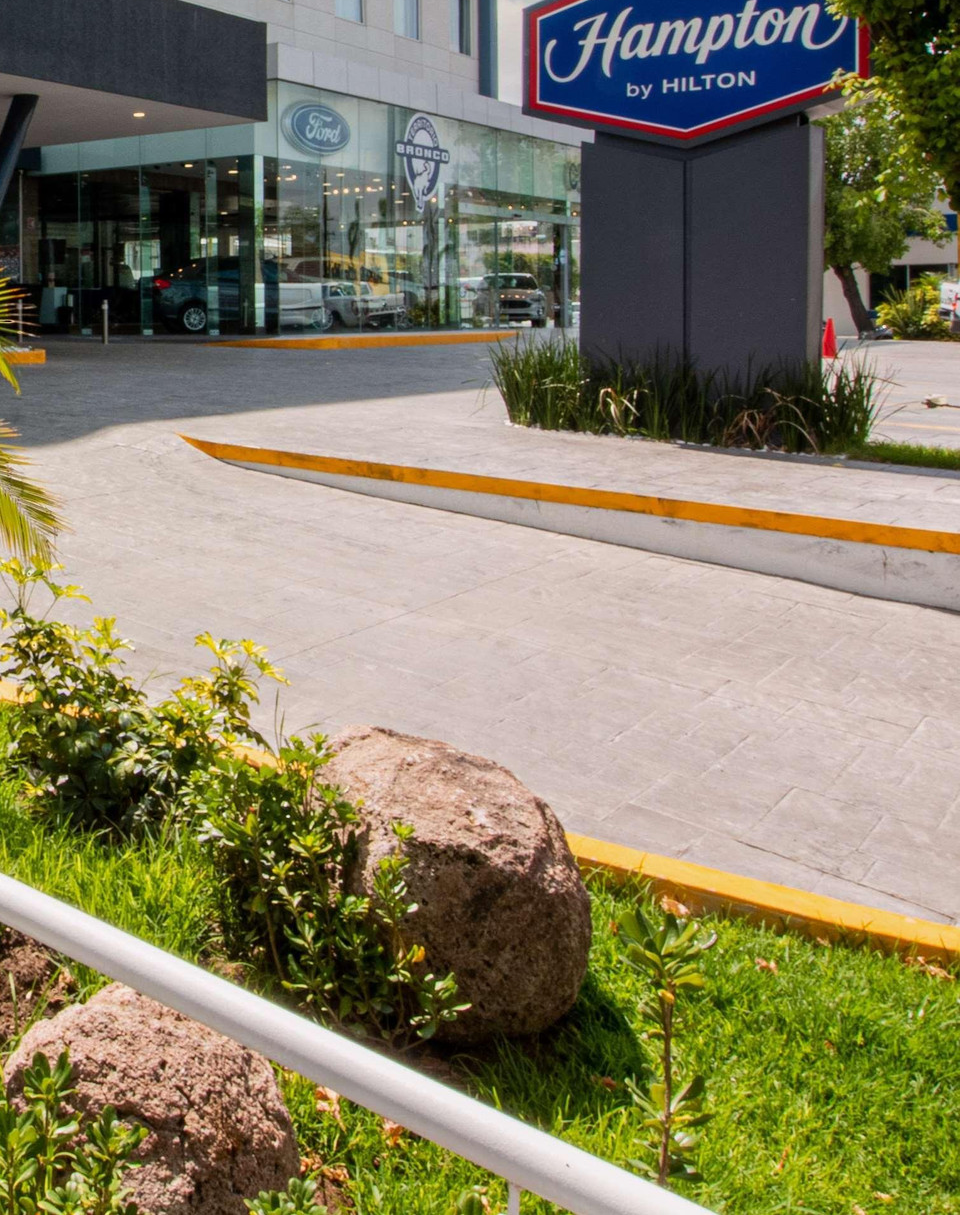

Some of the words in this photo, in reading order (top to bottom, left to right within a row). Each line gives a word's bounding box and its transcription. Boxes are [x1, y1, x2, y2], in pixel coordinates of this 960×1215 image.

[627, 83, 652, 99] by
[662, 71, 755, 94] HILTON
[306, 112, 341, 143] Ford
[396, 144, 449, 162] BRONCO
